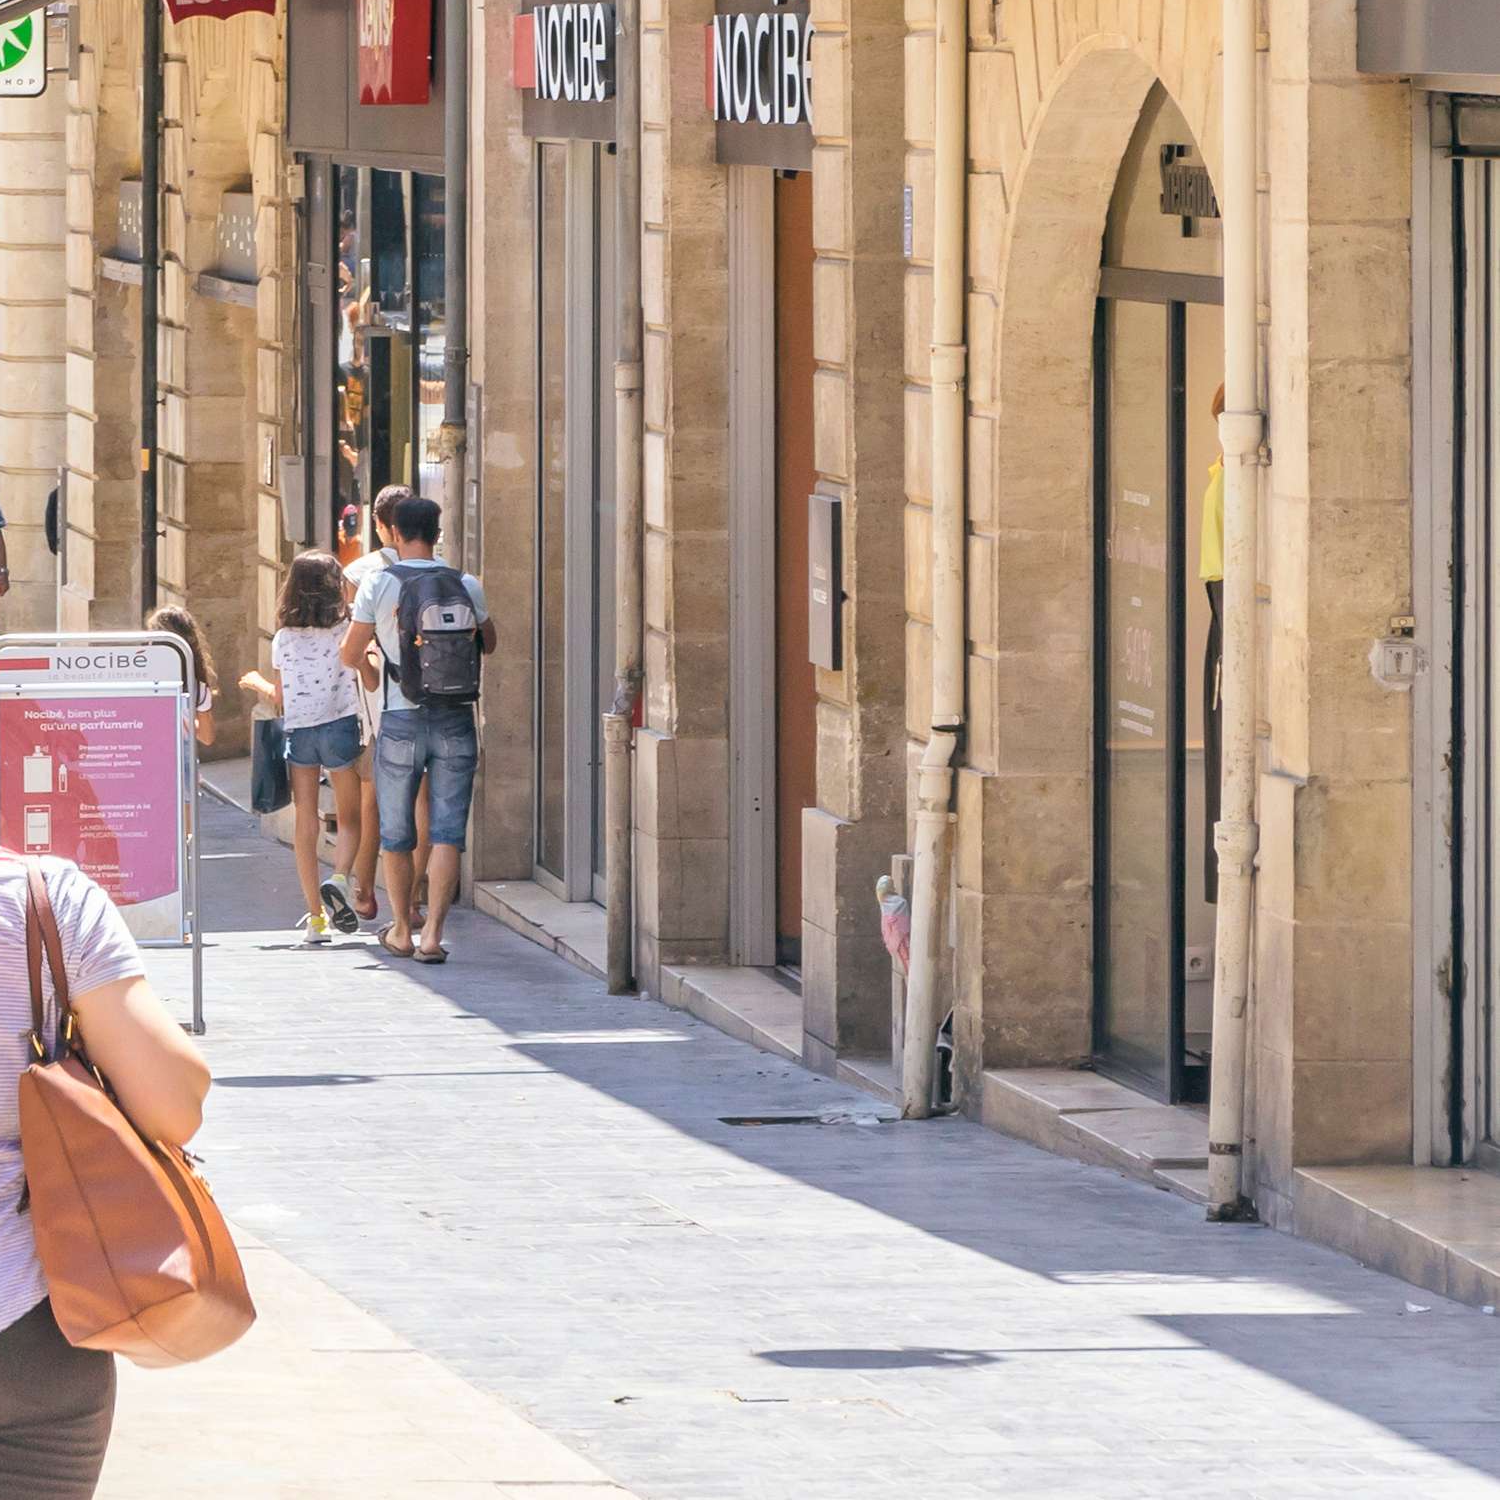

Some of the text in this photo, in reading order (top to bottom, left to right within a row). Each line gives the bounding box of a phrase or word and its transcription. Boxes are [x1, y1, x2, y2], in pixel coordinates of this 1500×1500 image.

[67, 709, 92, 719] bien
[94, 708, 118, 720] plus
[40, 718, 145, 732] qu'une parfumerie
